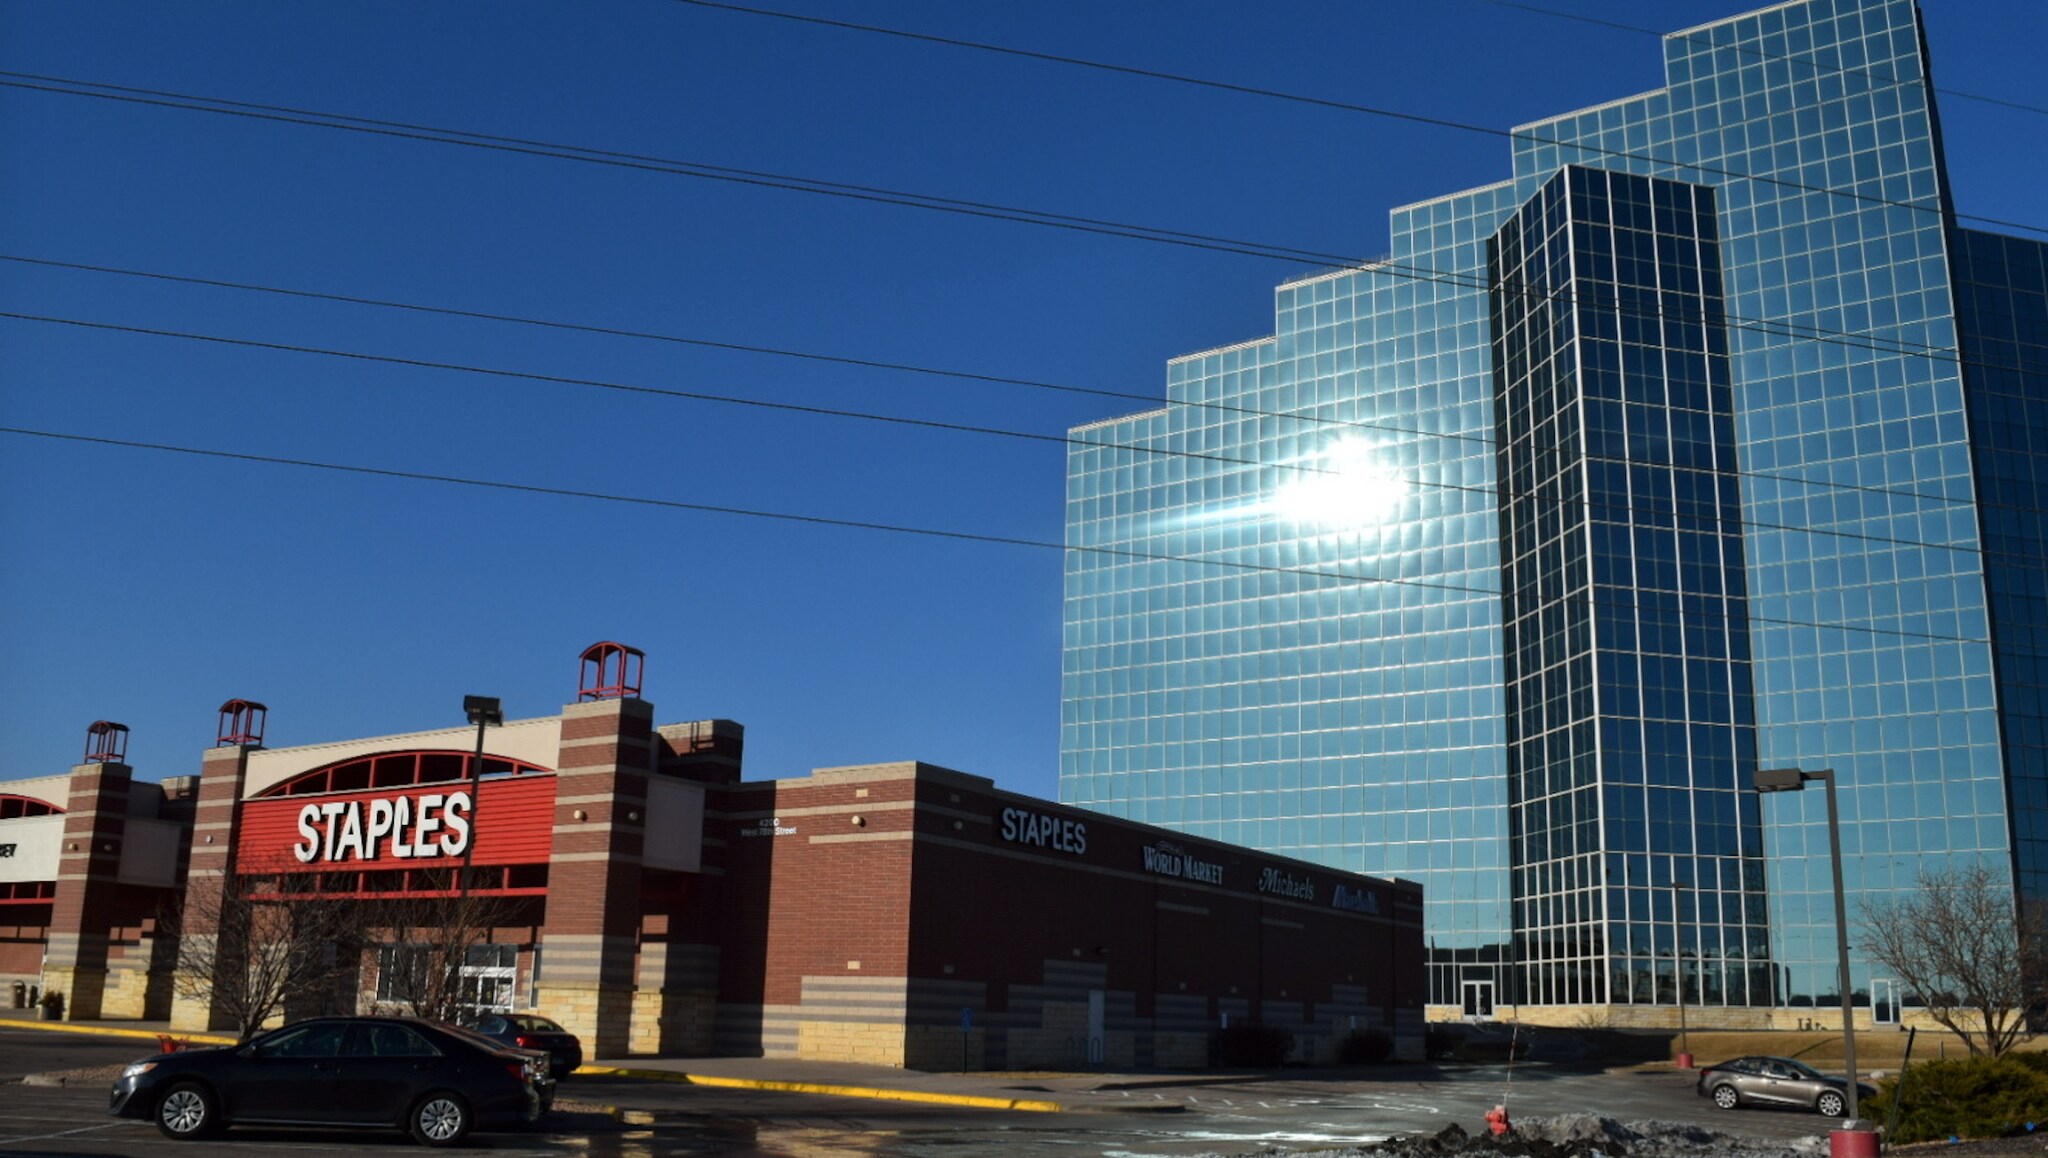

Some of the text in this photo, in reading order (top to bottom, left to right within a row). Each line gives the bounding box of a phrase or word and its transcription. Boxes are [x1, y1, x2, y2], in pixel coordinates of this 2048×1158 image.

[294, 791, 471, 863] STAPLES
[775, 826, 797, 836] Street
[1001, 806, 1087, 855] STAPLES
[1258, 867, 1315, 901] Michaels
